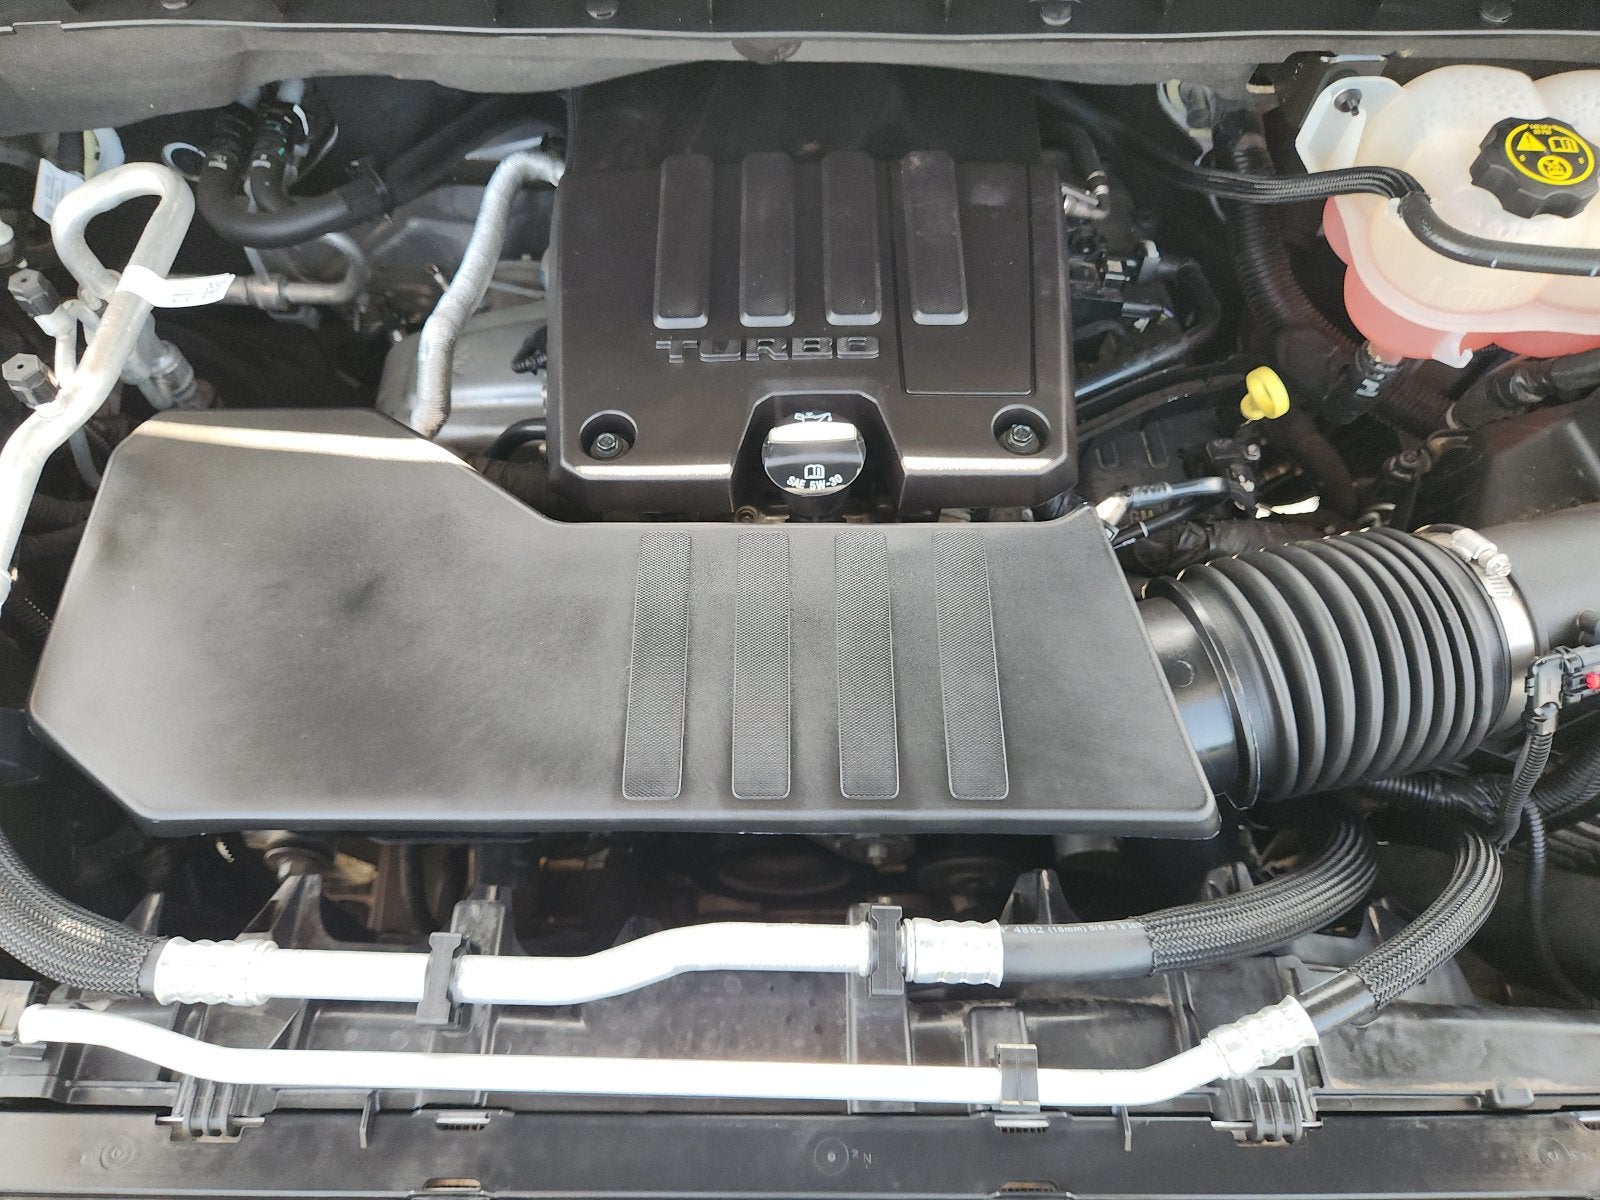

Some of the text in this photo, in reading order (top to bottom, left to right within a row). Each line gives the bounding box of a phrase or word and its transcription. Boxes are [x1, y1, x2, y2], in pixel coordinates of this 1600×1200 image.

[656, 337, 879, 363] TURBO
[787, 473, 844, 490] SAE 5W-30
[1013, 926, 1045, 935] 4882
[1106, 923, 1118, 932] in
